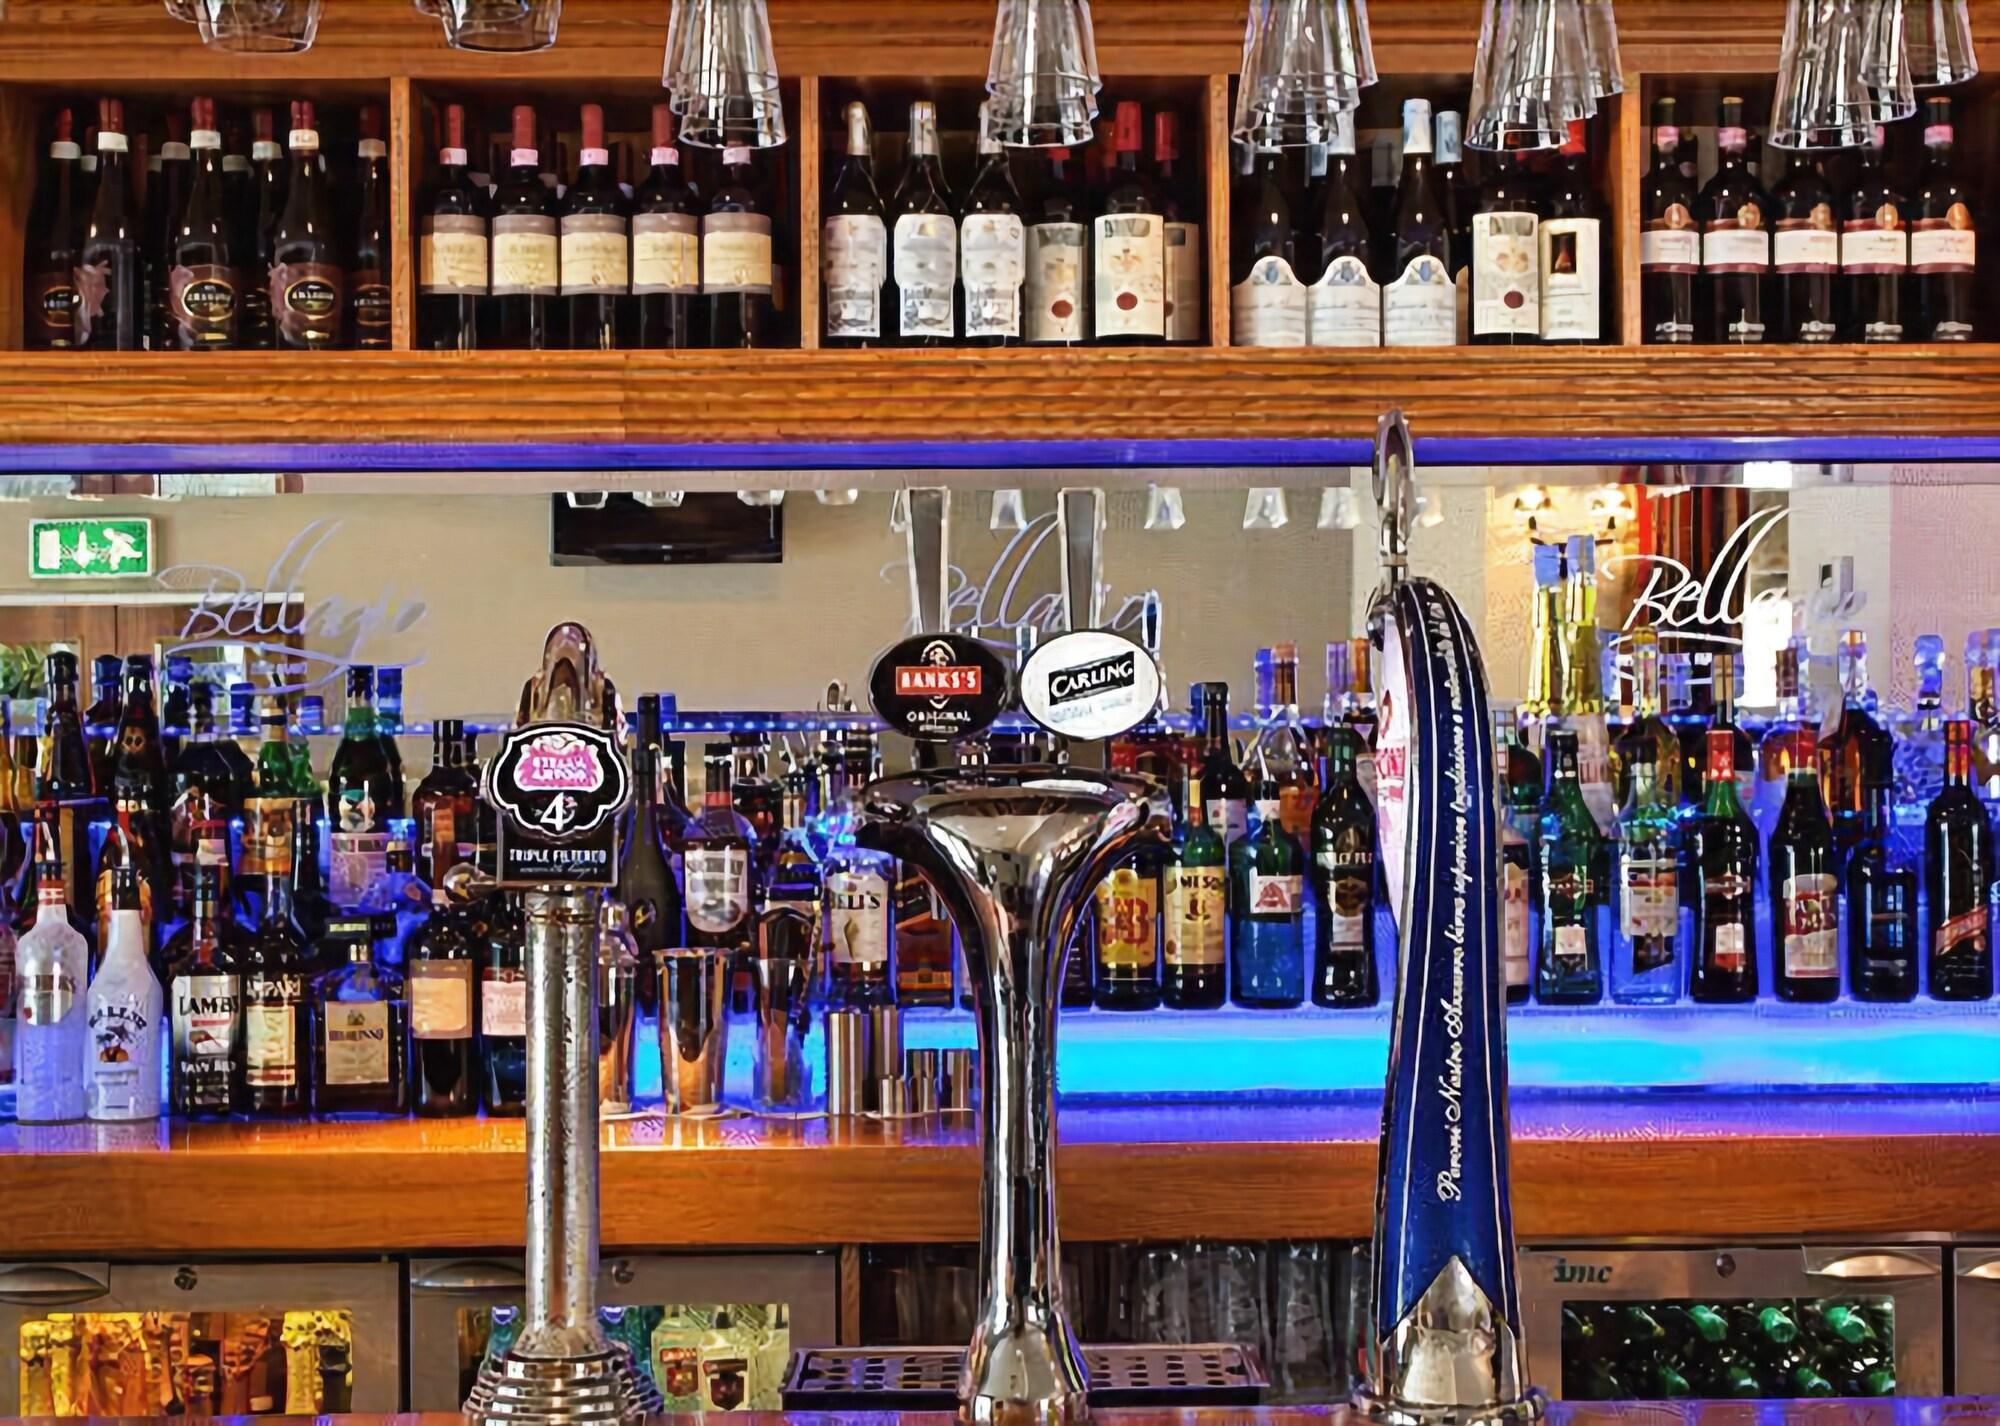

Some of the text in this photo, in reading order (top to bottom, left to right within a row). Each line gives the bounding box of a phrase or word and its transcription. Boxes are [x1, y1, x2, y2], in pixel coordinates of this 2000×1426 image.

[901, 671, 977, 689] BANKS'S
[1050, 660, 1134, 698] CARLING
[1436, 1124, 1462, 1202] Peroni
[1553, 1257, 1614, 1284] imc
